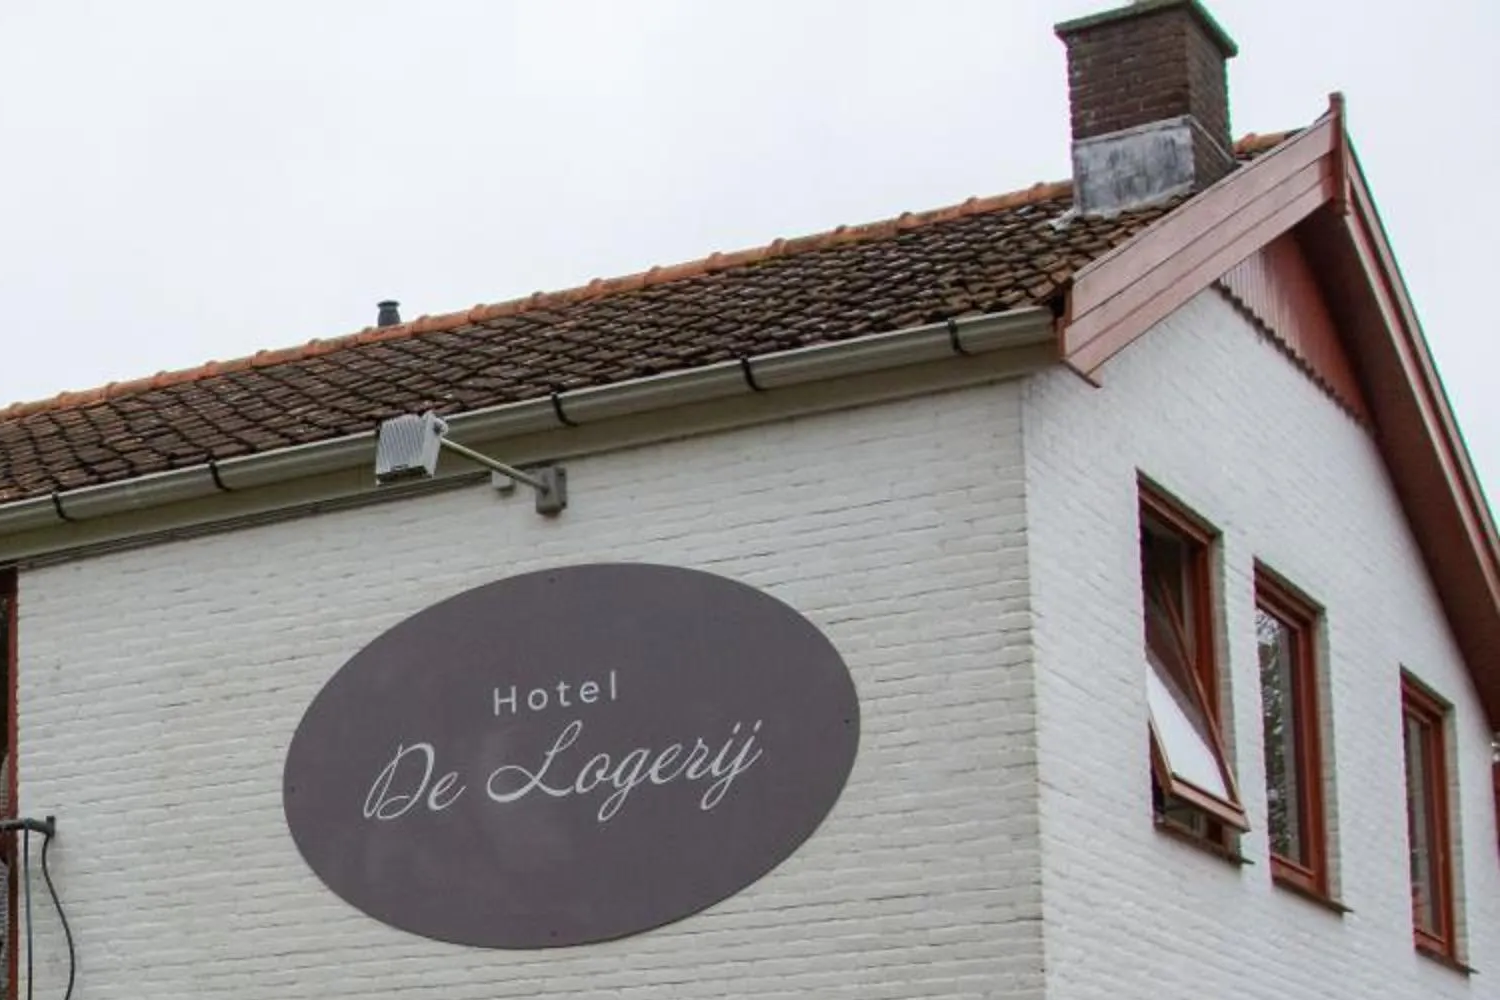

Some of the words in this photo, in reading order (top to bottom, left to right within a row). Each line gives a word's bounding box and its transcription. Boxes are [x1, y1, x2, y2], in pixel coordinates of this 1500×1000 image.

[493, 670, 618, 716] Hotel
[363, 741, 467, 820] De
[486, 720, 763, 823] Logerij
